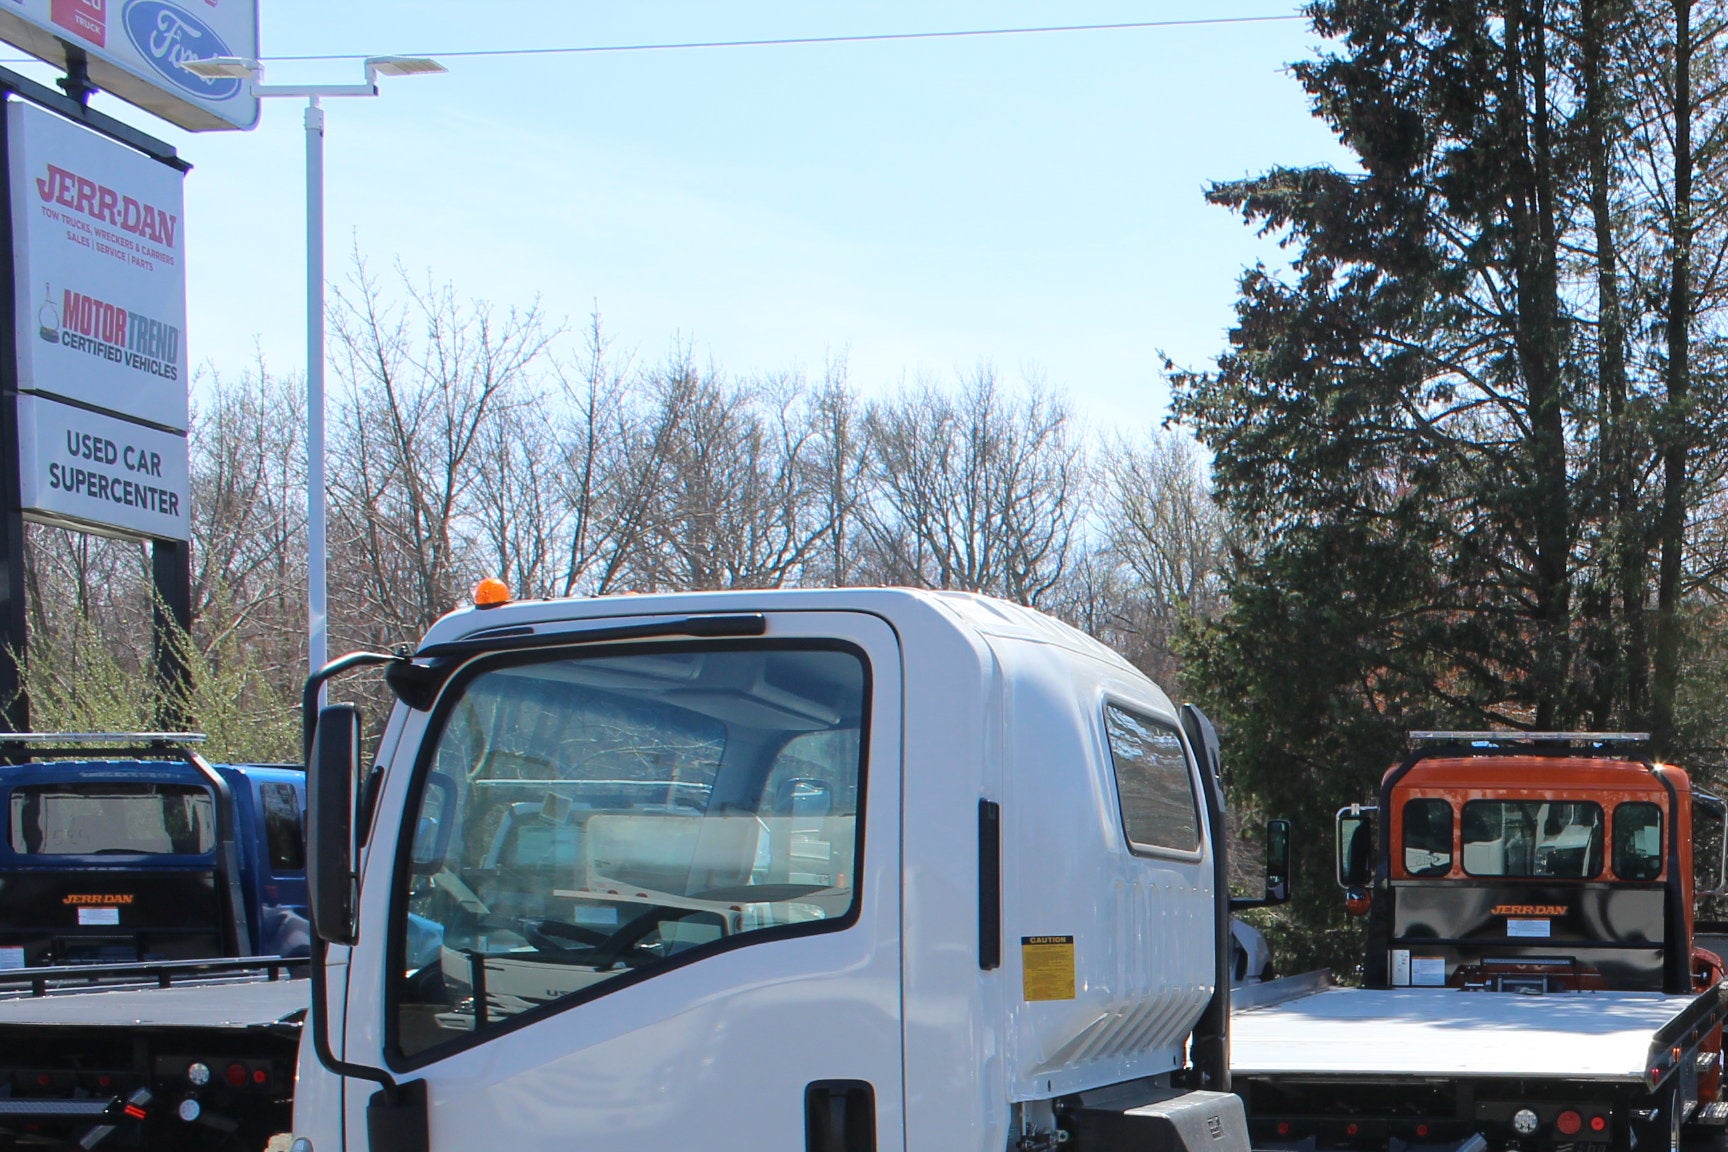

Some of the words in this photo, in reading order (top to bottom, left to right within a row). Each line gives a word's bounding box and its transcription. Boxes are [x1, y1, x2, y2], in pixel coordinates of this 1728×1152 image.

[74, 14, 101, 34] TRUCK
[41, 206, 60, 221] TOW
[61, 213, 93, 236] TRUCKS,
[93, 226, 135, 250] WRECKERS
[141, 245, 175, 266] CARRIERS
[66, 231, 90, 248] SALES
[95, 242, 127, 261] SERVICE
[131, 255, 154, 272] PARTS
[61, 330, 123, 364] CERTIFIED
[124, 351, 178, 381] VEHICLES
[67, 429, 118, 465] USED
[123, 445, 162, 478] CAR
[49, 462, 180, 517] SUPERCENTER
